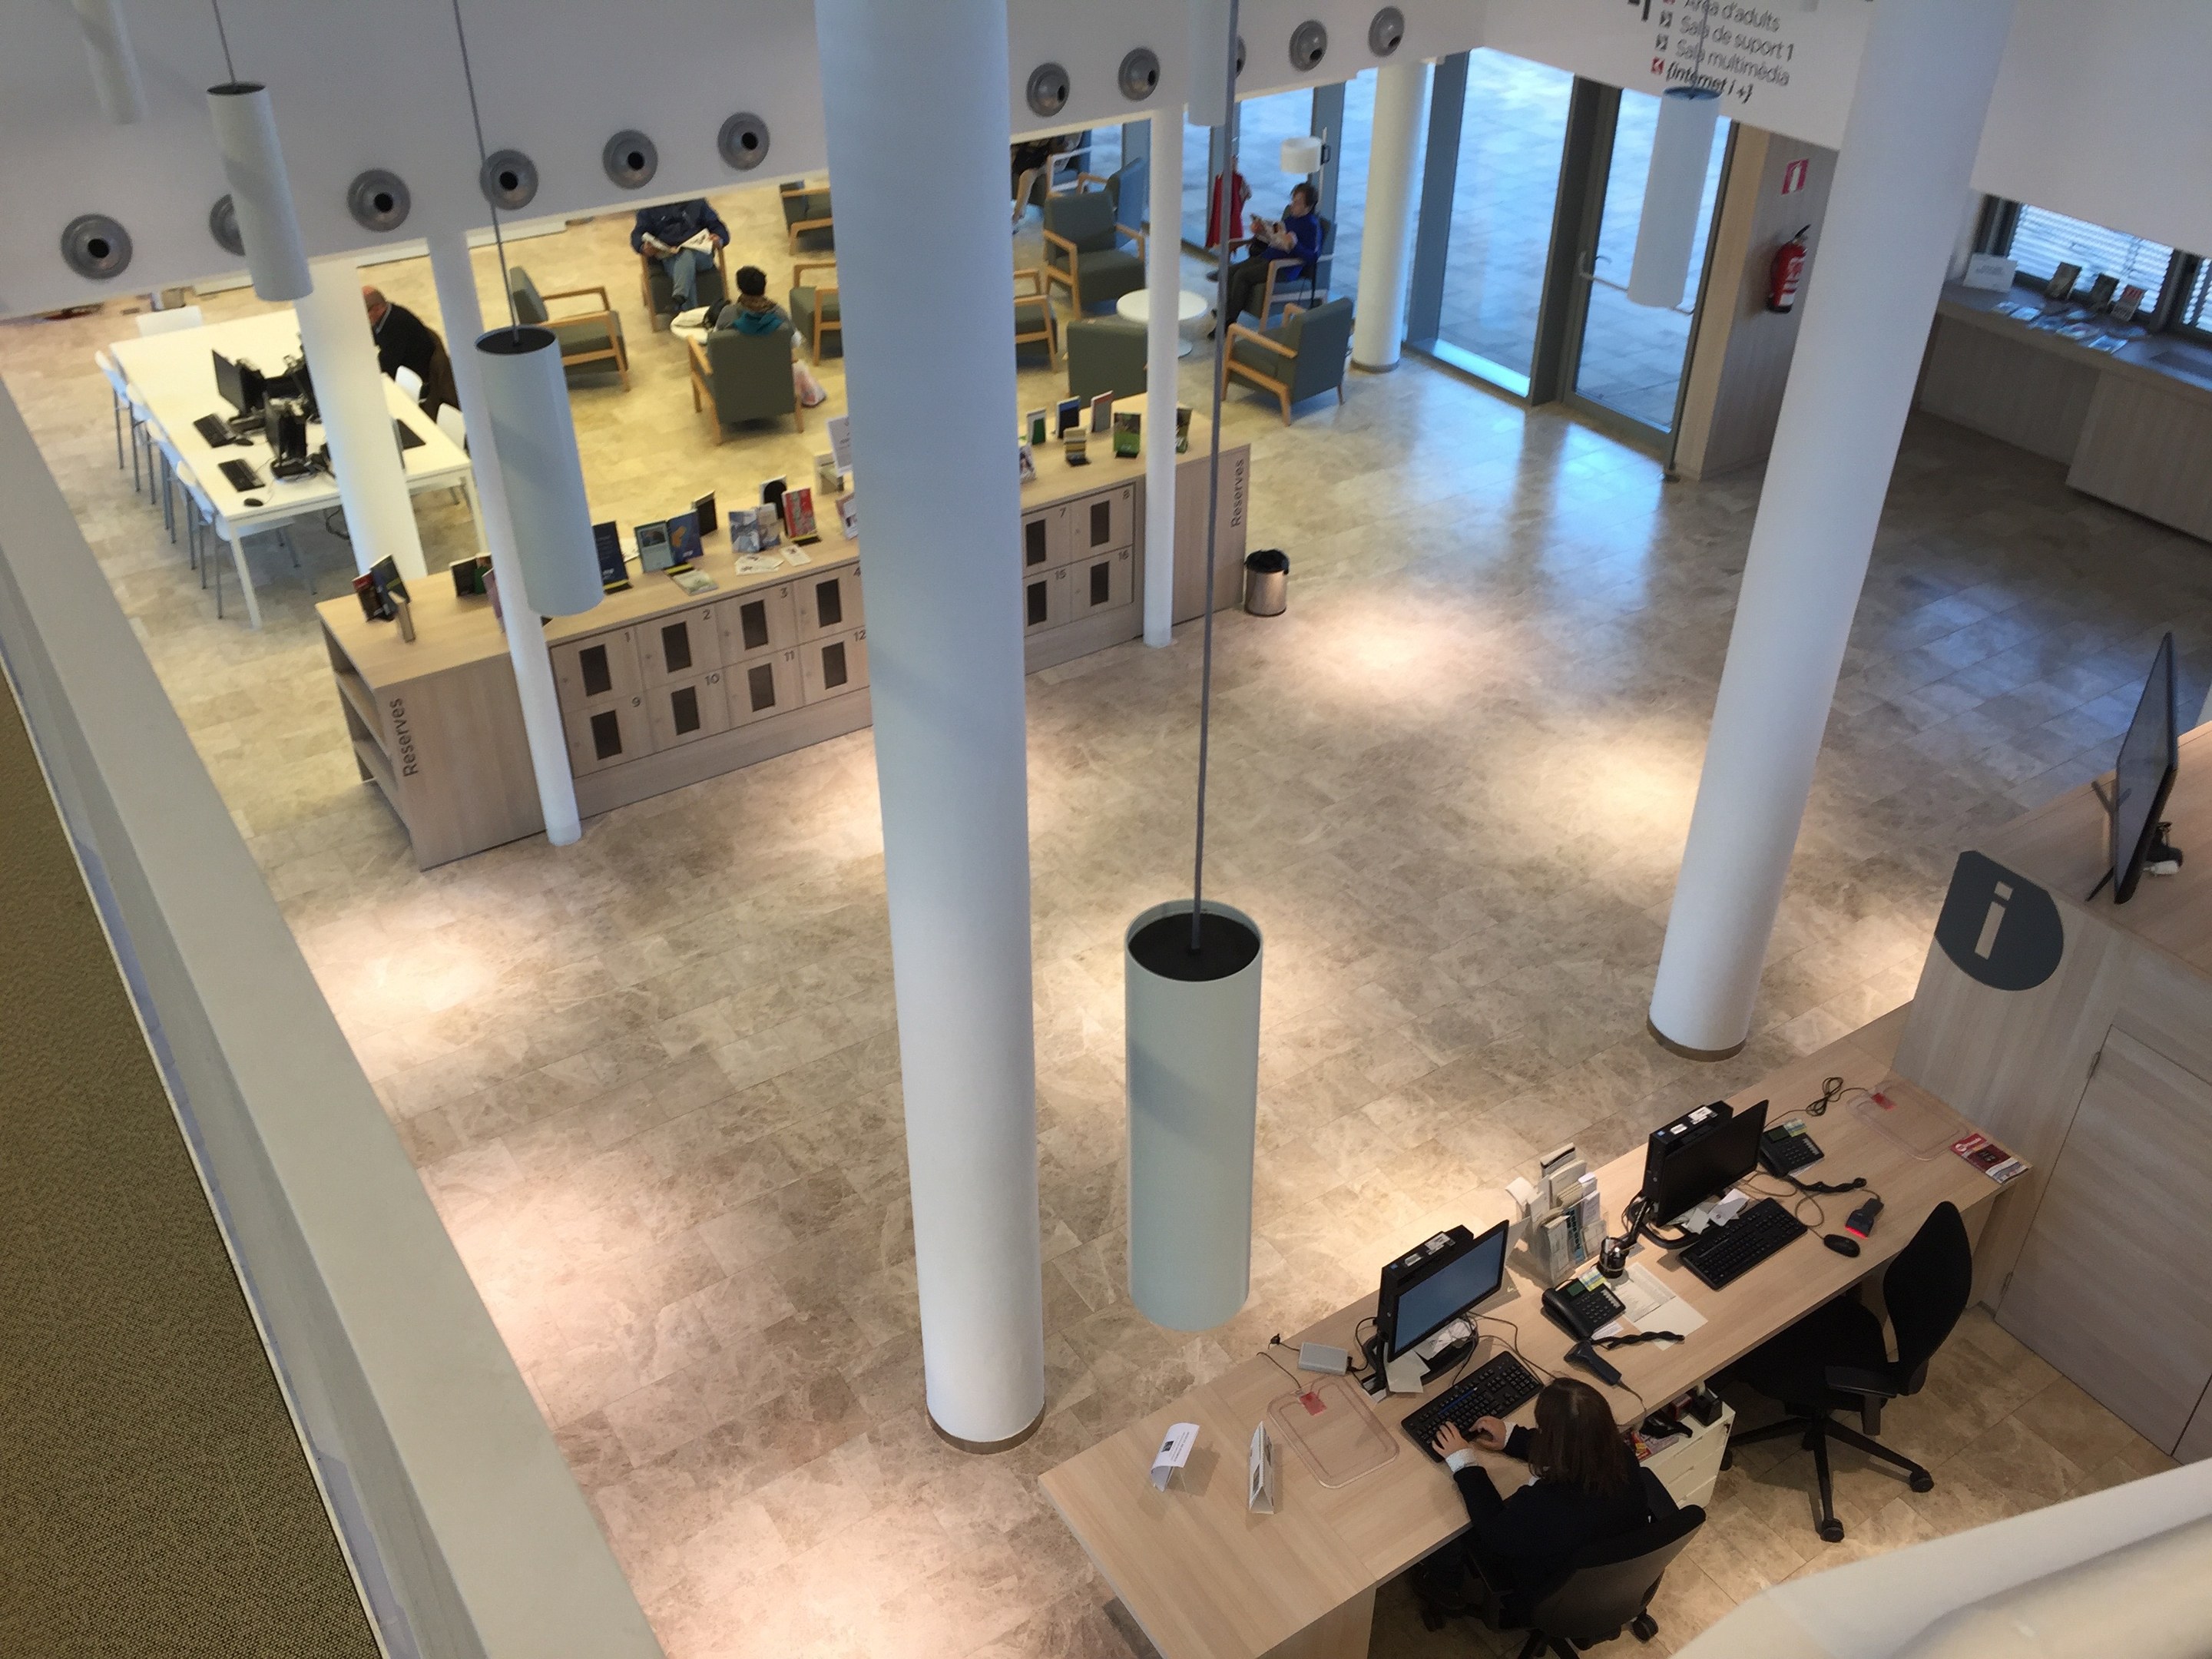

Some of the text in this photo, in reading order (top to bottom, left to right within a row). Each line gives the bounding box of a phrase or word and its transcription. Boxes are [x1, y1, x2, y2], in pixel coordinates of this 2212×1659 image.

[1680, 15, 1794, 61] Sala de suport 1
[1676, 39, 1705, 62] Sala
[1230, 459, 1244, 528] Reserves
[1059, 507, 1066, 518] 7
[1055, 569, 1066, 581] 15
[780, 587, 788, 599] 3
[703, 610, 710, 621] 2
[624, 632, 630, 642] 1
[853, 629, 866, 641] 12
[784, 651, 794, 661] 11
[704, 673, 720, 686] 10
[632, 696, 641, 707] 9
[389, 697, 419, 777] Reserves
